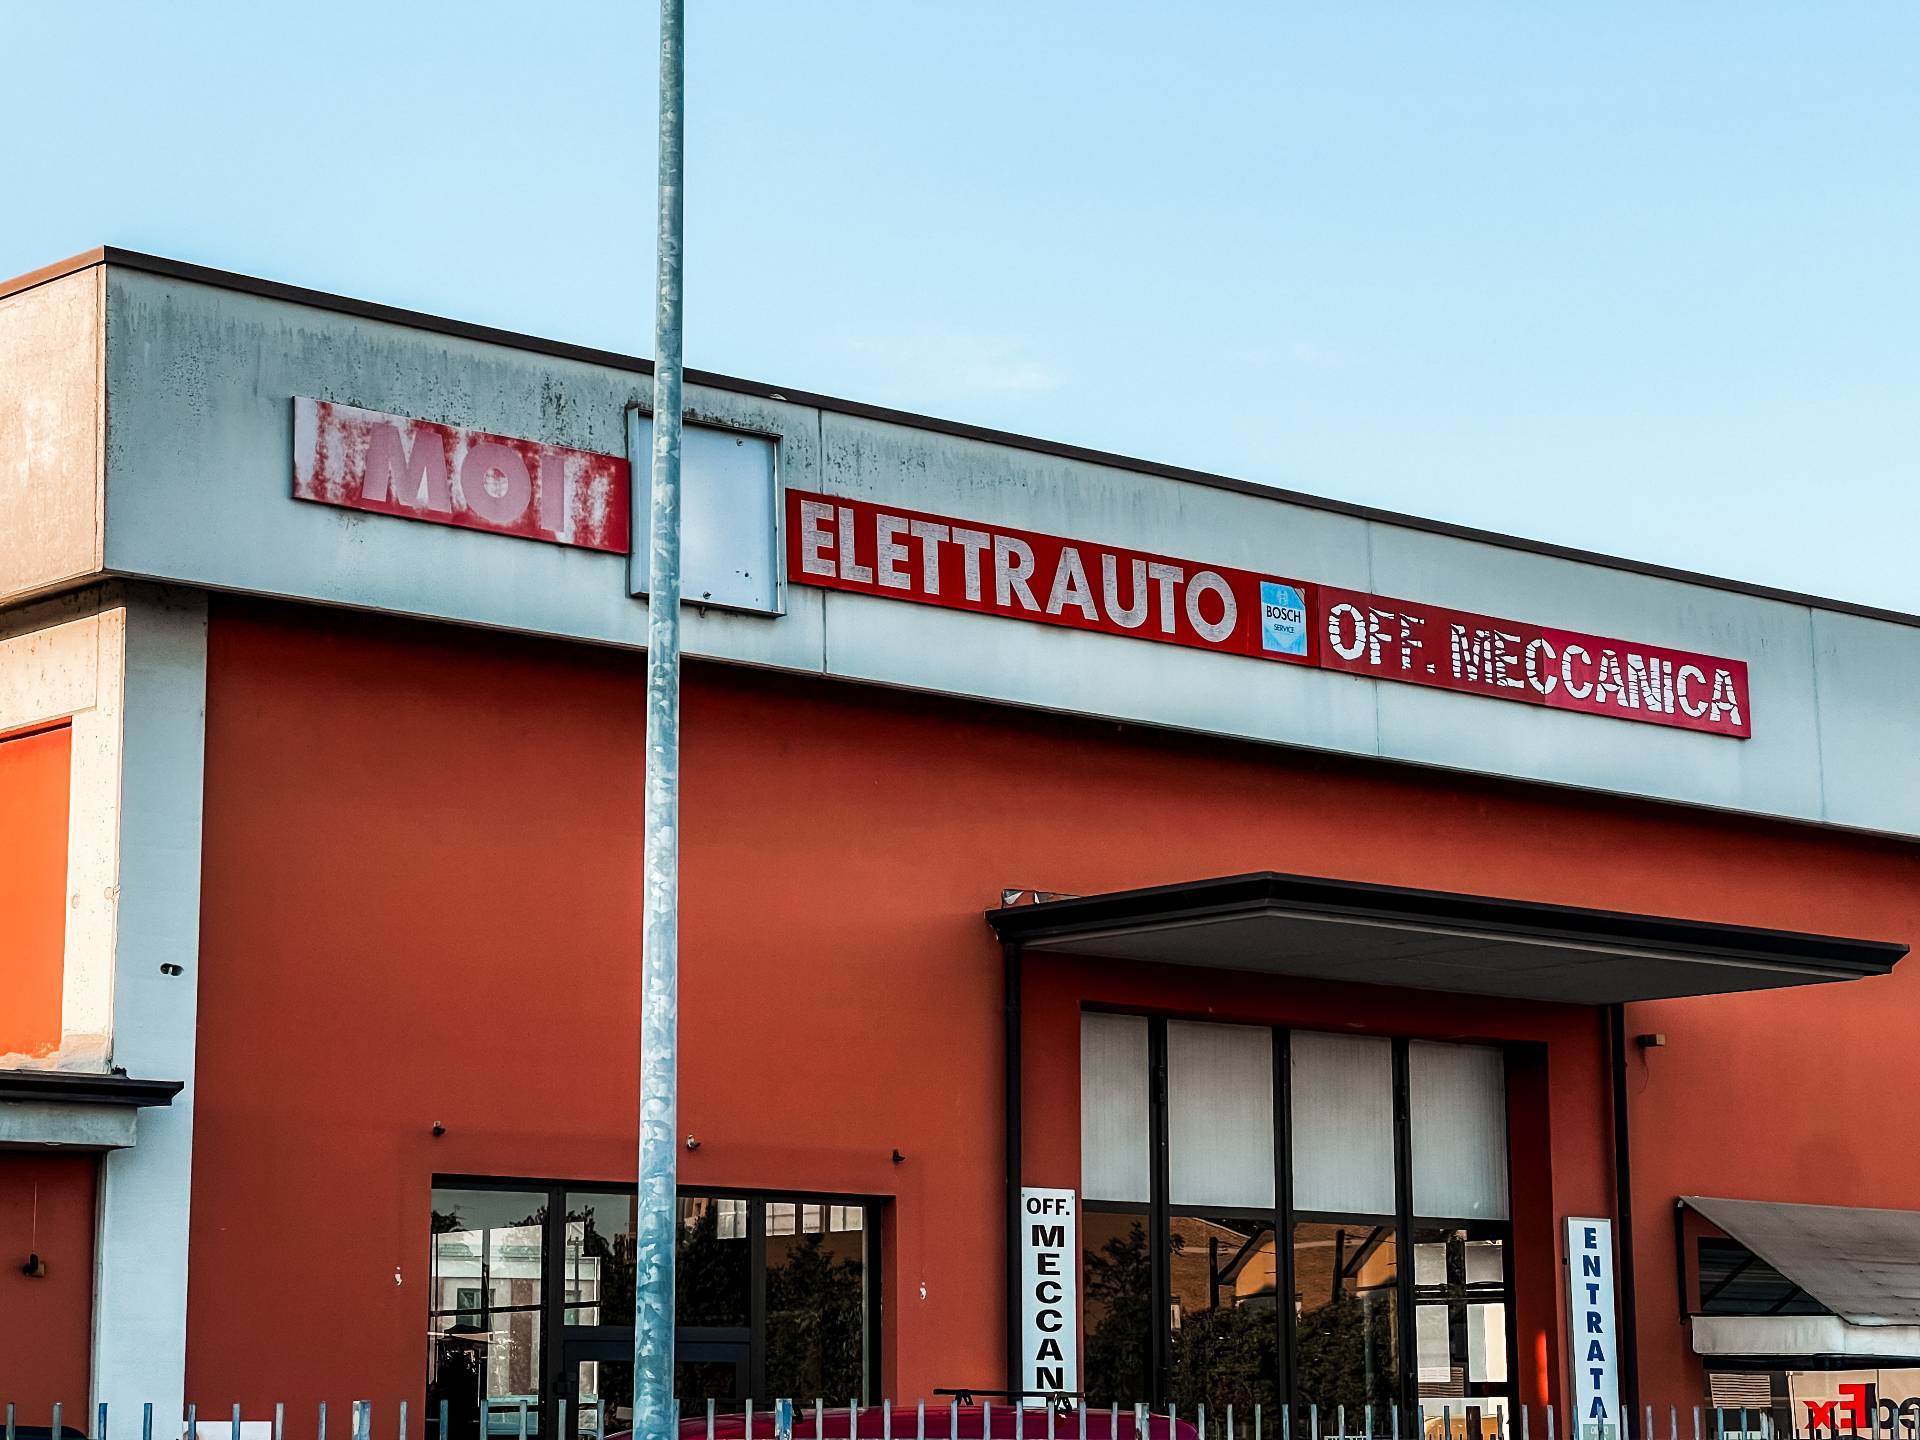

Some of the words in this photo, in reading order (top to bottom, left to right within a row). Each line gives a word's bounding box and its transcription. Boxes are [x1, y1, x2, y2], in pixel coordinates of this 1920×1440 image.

[801, 500, 1237, 642] ELETTRAUTO
[1266, 605, 1301, 623] BOSCH
[1273, 623, 1295, 634] SERVICE
[1328, 603, 1435, 674] OFF.
[1451, 623, 1741, 726] MECCANICA
[1026, 1198, 1070, 1215] OFF.
[1032, 1225, 1064, 1407] MECCAN
[1582, 1227, 1608, 1418] ENTRATA
